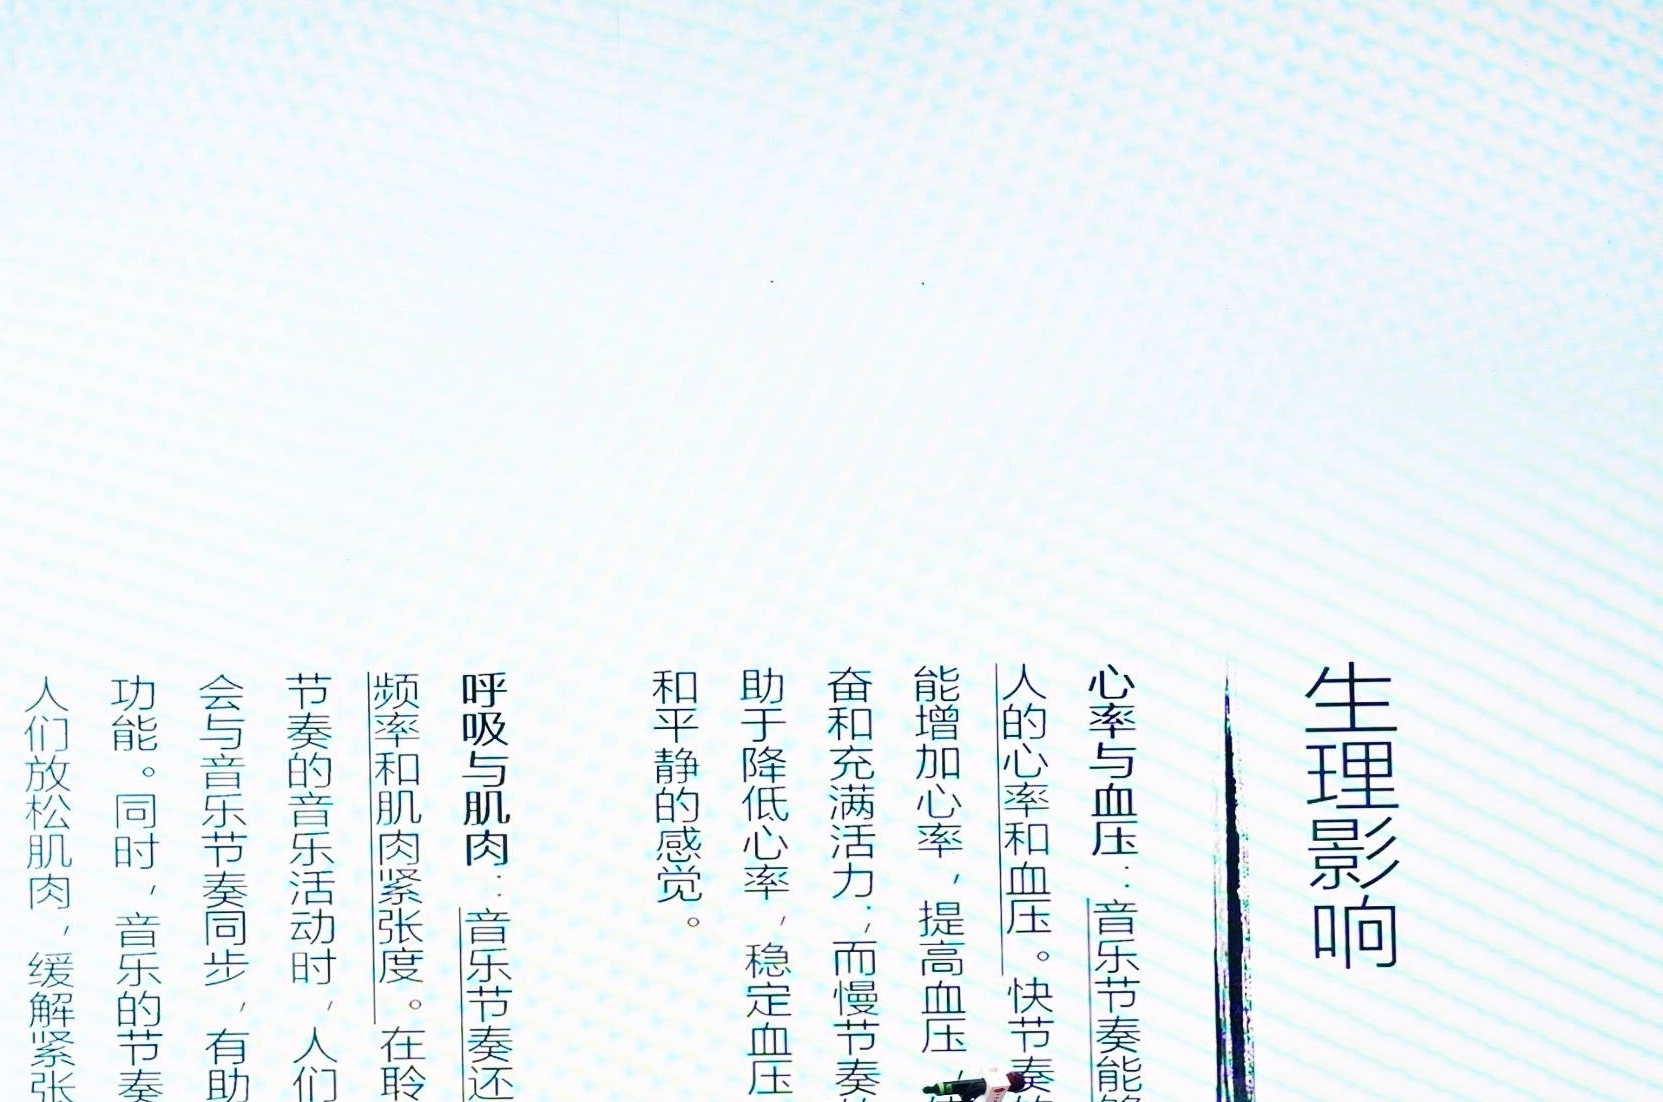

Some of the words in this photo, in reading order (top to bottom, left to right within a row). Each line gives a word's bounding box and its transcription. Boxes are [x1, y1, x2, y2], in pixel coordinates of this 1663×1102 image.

[653, 670, 703, 929] 和平静的感觉。
[1305, 662, 1399, 969] 生理影响
